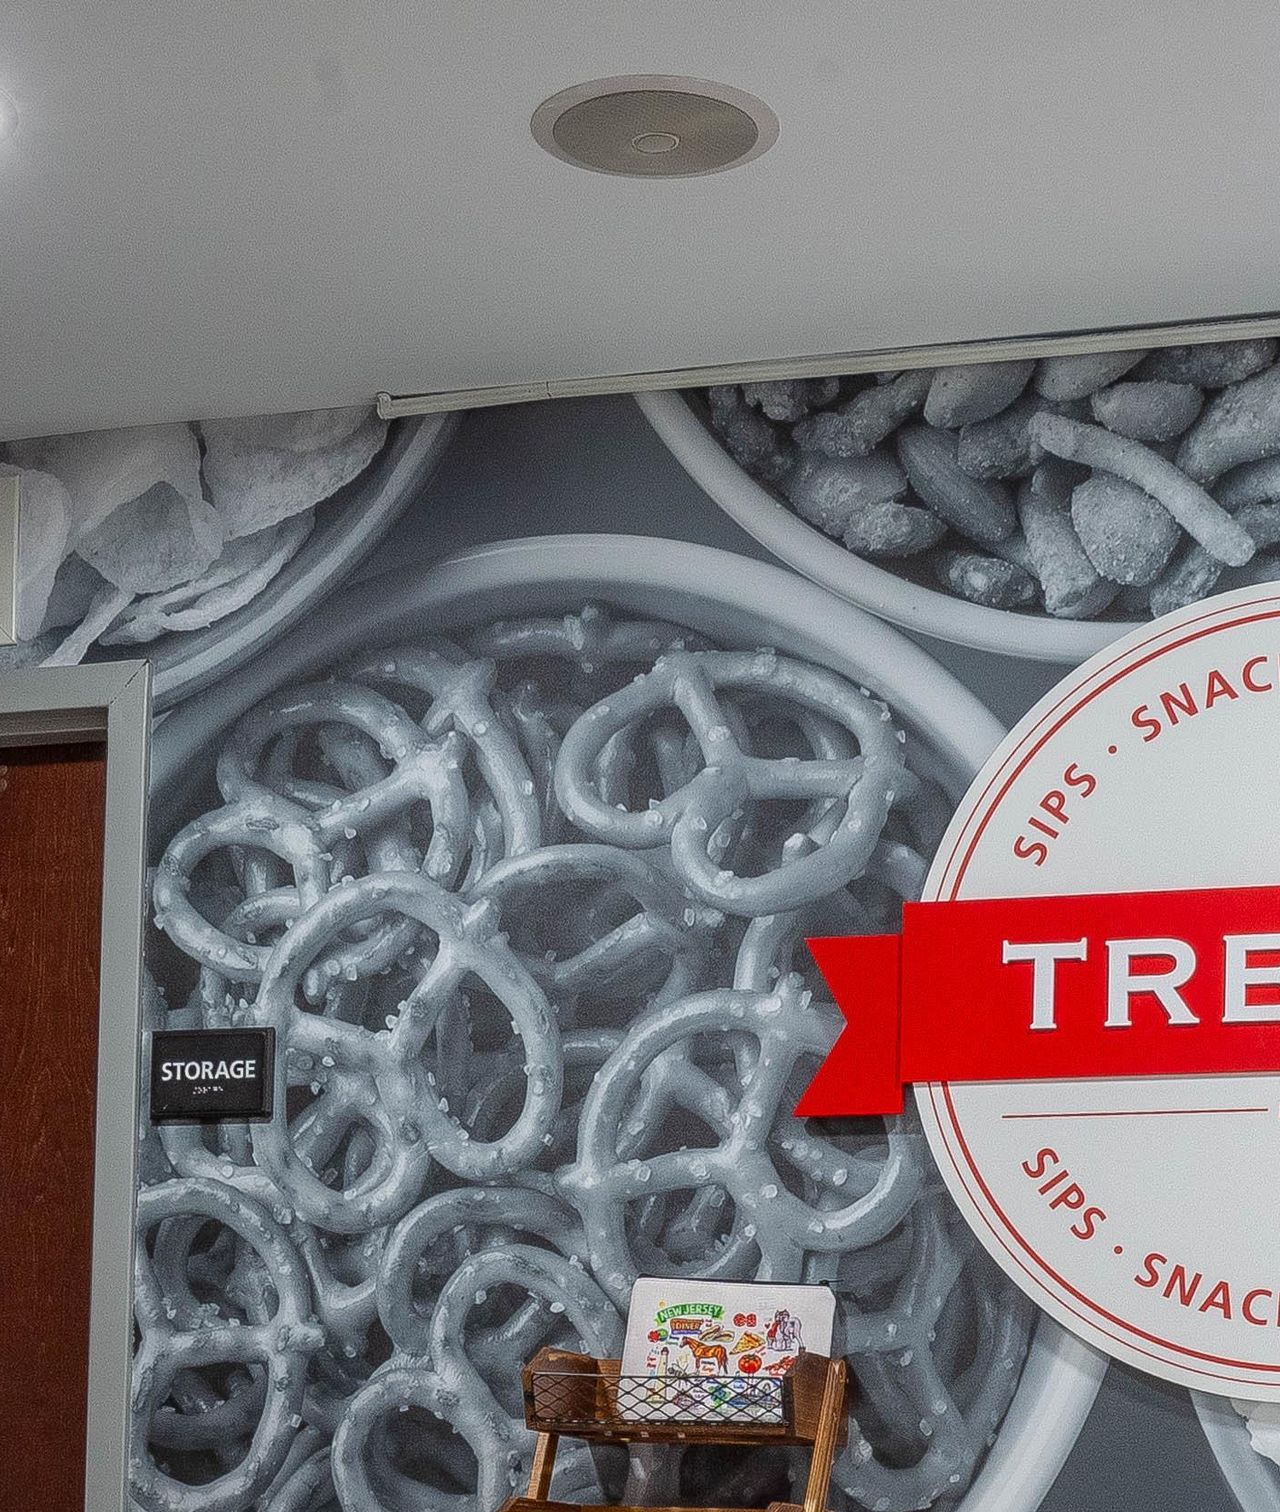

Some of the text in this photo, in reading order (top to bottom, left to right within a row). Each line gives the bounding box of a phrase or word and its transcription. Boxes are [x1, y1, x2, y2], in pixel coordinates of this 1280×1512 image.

[1013, 765, 1096, 866] SIPS
[161, 1060, 256, 1081] STORAGE
[1022, 1148, 1105, 1240] SIPS
[660, 1303, 721, 1321] NEW JERSEY
